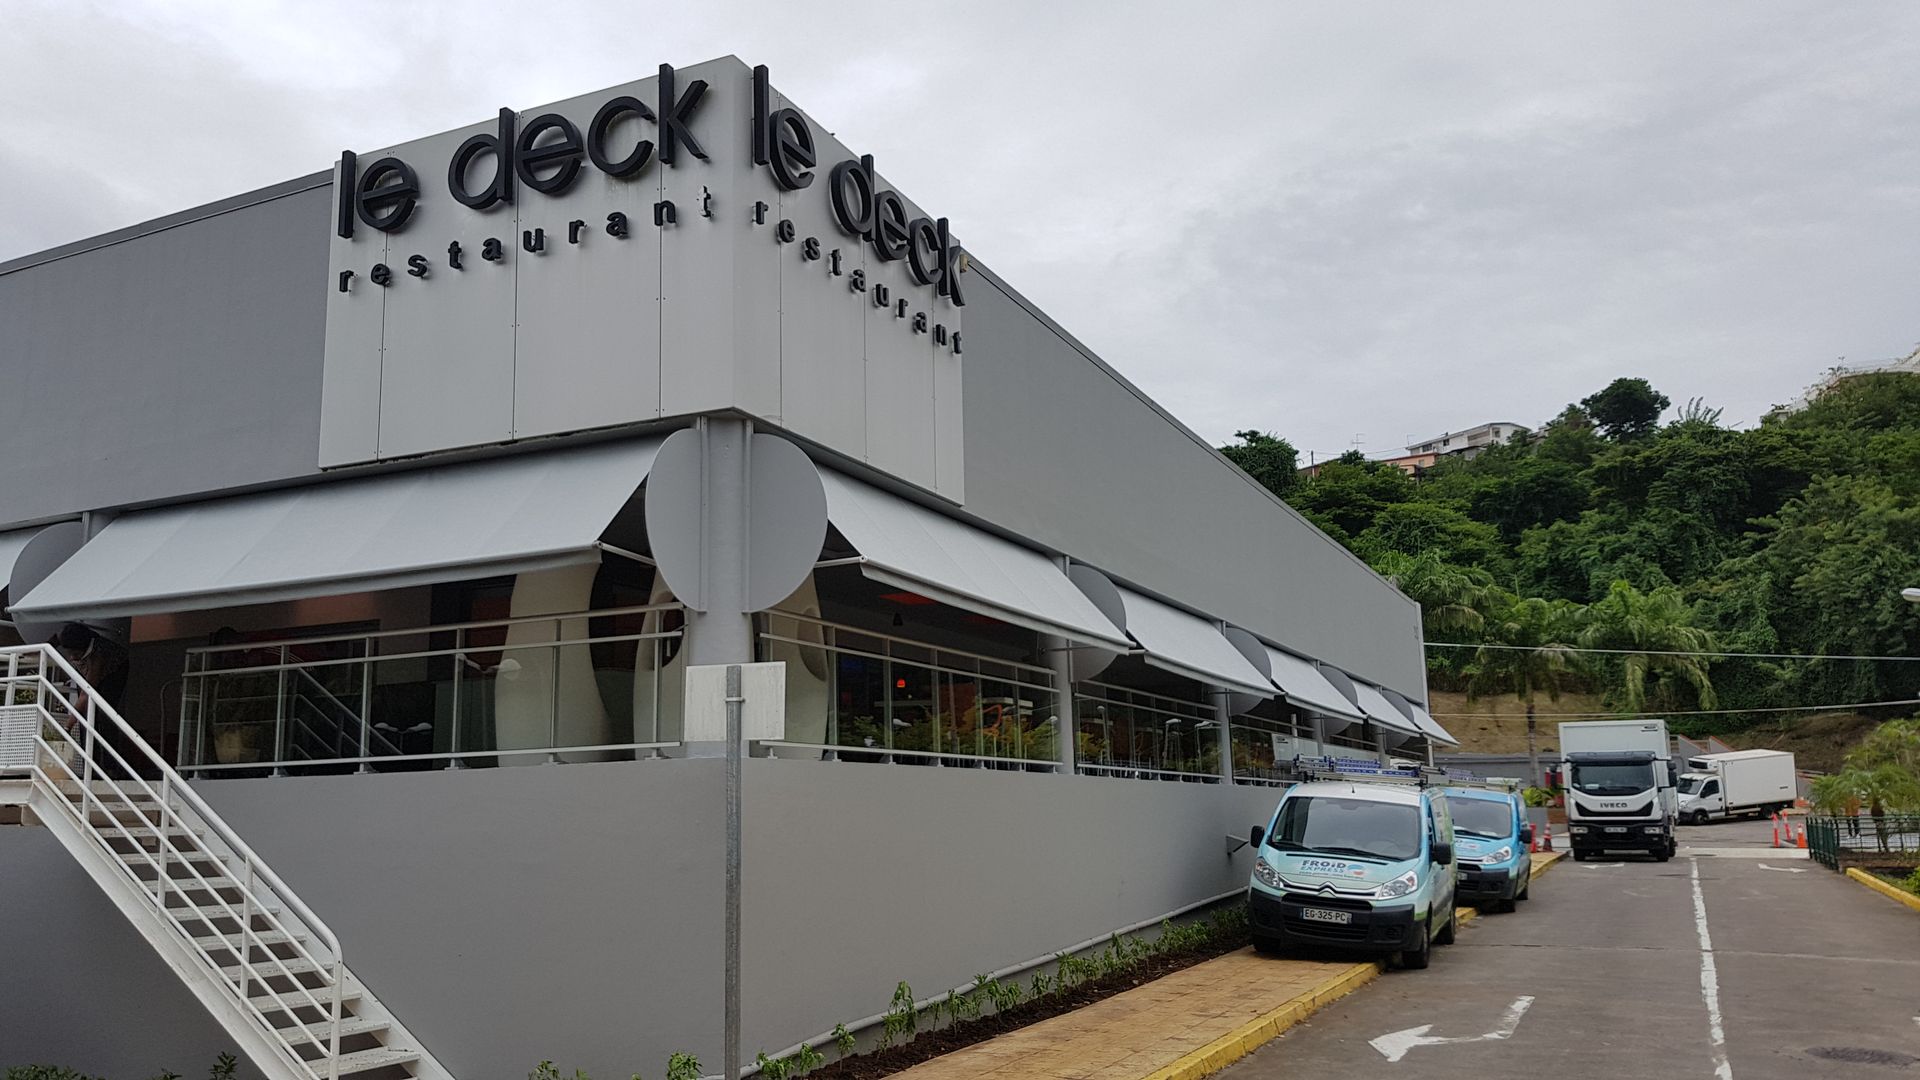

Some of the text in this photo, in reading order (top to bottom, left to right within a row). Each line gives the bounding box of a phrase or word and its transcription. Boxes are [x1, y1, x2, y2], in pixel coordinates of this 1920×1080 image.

[338, 63, 709, 240] le deck
[753, 64, 965, 307] le deck
[339, 186, 713, 293] restaurant
[755, 201, 962, 354] restaurant
